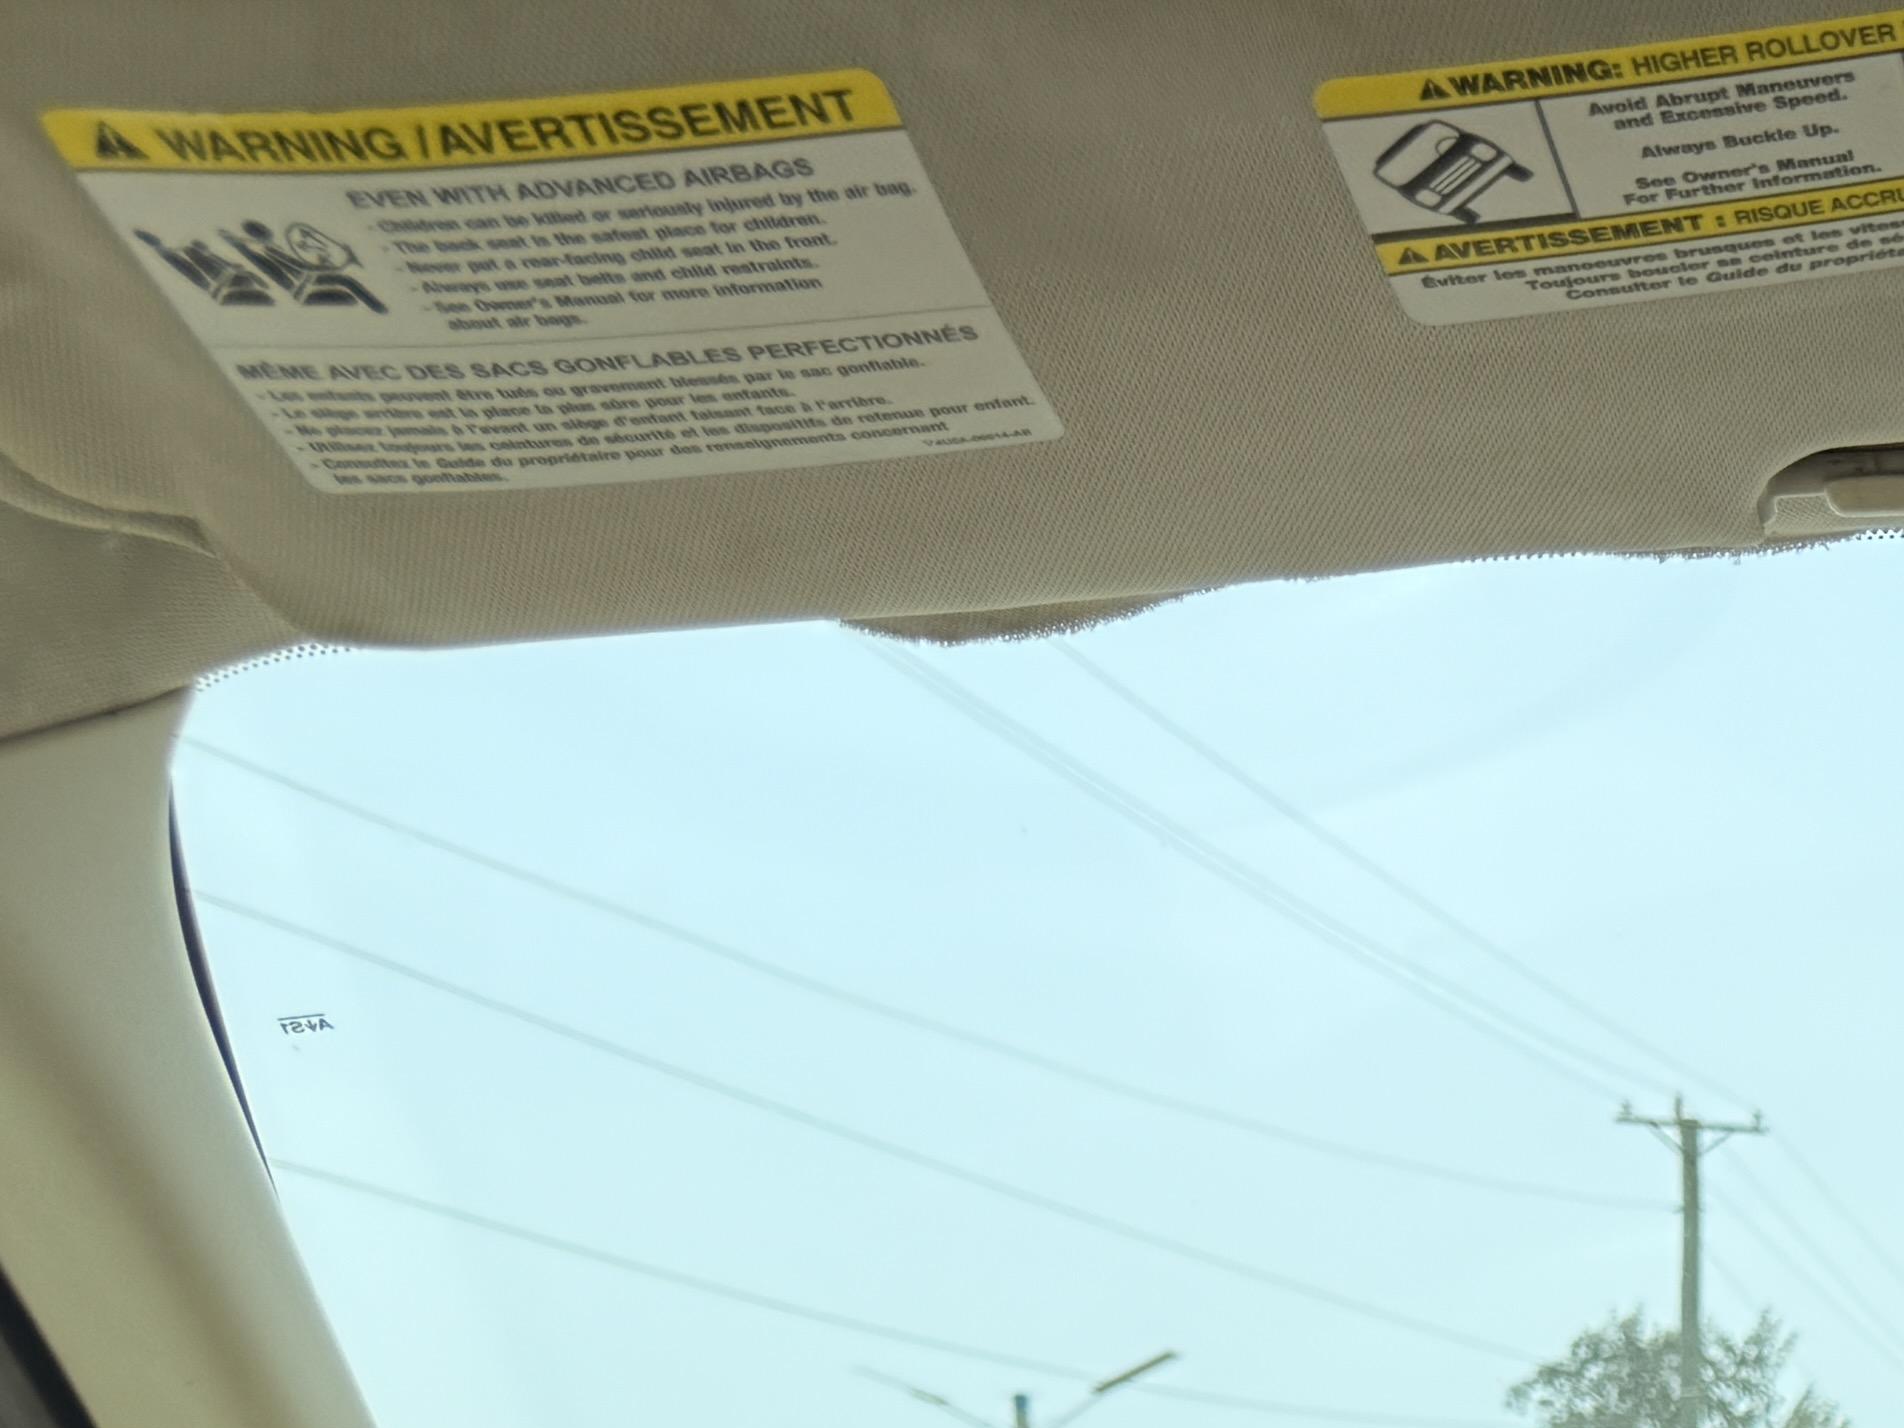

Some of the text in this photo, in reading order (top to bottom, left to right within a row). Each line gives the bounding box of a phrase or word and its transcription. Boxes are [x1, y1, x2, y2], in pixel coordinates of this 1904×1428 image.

[1447, 59, 1623, 96] WARNING:
[1631, 44, 1739, 76] HIGHER
[1744, 22, 1897, 62] ROLLOVER
[1588, 71, 1856, 117] Avoid Abrupt Maneuvers
[1613, 88, 1848, 131] and Excessive Speed.
[156, 126, 409, 162] WARNING
[438, 88, 853, 157] AVERTISSEMENT
[1641, 124, 1840, 159] Always Buckle Up.
[345, 157, 814, 209] EVEN WITH ADVANCED AIRBAGS
[1622, 164, 1882, 206] For Further Information.
[1634, 149, 1855, 190] See Owner's Manual
[1434, 213, 1703, 261] AVERTISSEMENT
[1733, 199, 1825, 225] RISQUE
[236, 324, 979, 381] MÊME AVEC DES SACS GONFLABLES PERFECTIONNÉS
